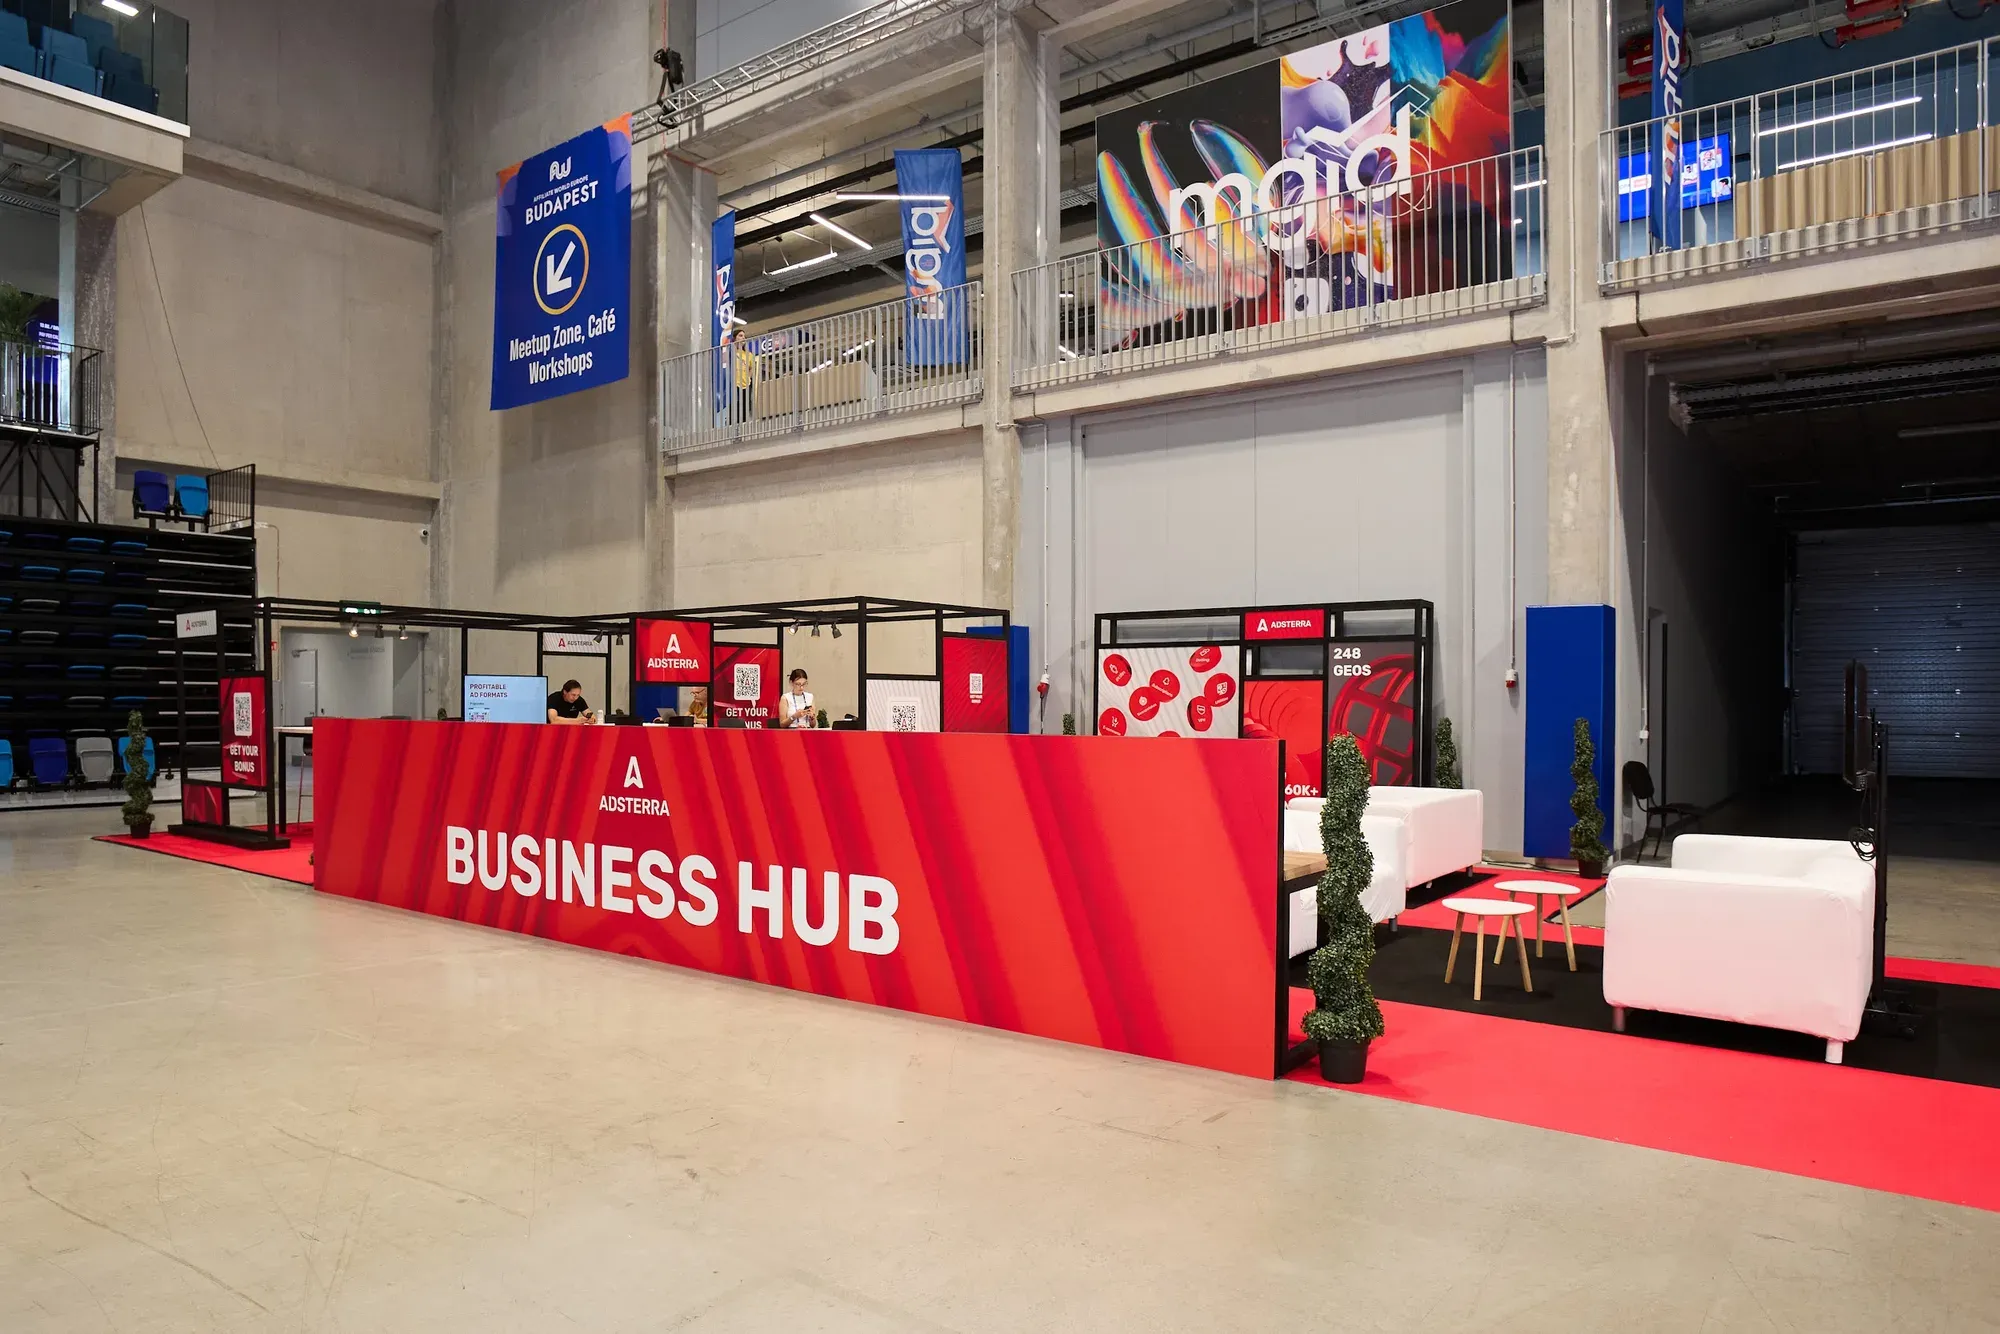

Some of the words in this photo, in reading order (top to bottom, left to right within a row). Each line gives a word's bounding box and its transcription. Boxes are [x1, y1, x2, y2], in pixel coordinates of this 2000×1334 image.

[1169, 102, 1411, 251] mgid
[533, 189, 554, 202] AFFILIATE
[554, 182, 571, 194] WORLD
[570, 174, 589, 187] EUROPE
[525, 180, 599, 225] BUDAPEST
[509, 334, 551, 362] Meetup
[553, 324, 585, 349] Zone,
[587, 307, 616, 339] Café
[528, 351, 593, 385] Workshops
[1270, 620, 1312, 629] ADSTERRA
[1333, 647, 1362, 660] 248
[647, 657, 700, 670] ADSTERRA
[1333, 664, 1372, 677] GEOS
[725, 707, 743, 717] GET
[744, 707, 768, 717] YOUR
[229, 745, 241, 756] GET
[241, 745, 259, 757] YOUR
[234, 760, 255, 773] BONUS
[1284, 784, 1319, 797] 60K+
[599, 795, 670, 817] ADSTERRA
[446, 825, 719, 927] BUSINESS
[737, 860, 900, 956] HUB
